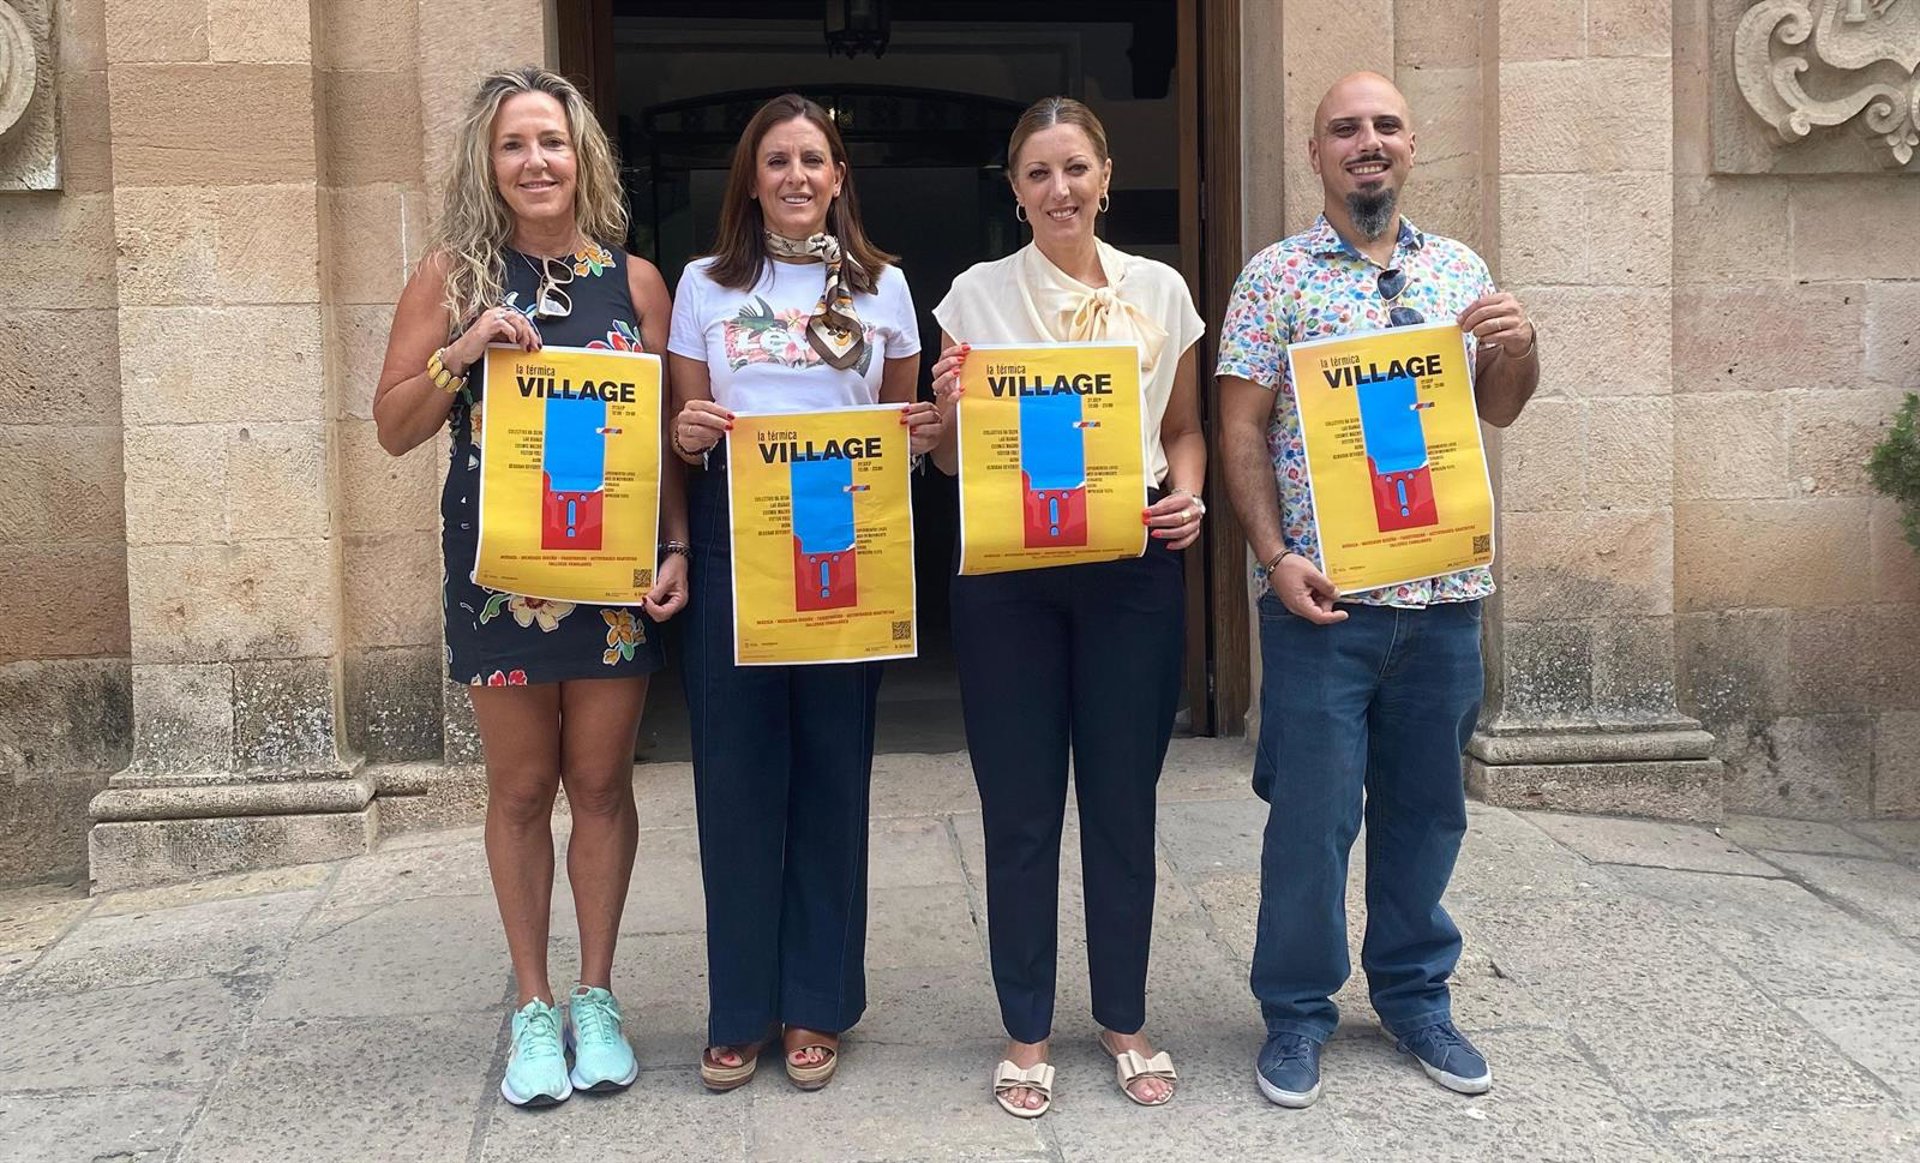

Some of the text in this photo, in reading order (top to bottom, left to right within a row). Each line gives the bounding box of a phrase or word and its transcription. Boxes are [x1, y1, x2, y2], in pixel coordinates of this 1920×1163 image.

[516, 364, 555, 377] la térmica
[986, 364, 995, 374] la
[1320, 358, 1329, 369] la
[1323, 354, 1443, 389] VILLAGE
[516, 376, 636, 403] VILLAGE
[988, 373, 1113, 397] VILLAGE
[757, 430, 797, 441] la térmica
[758, 437, 883, 464] VILLAGE
